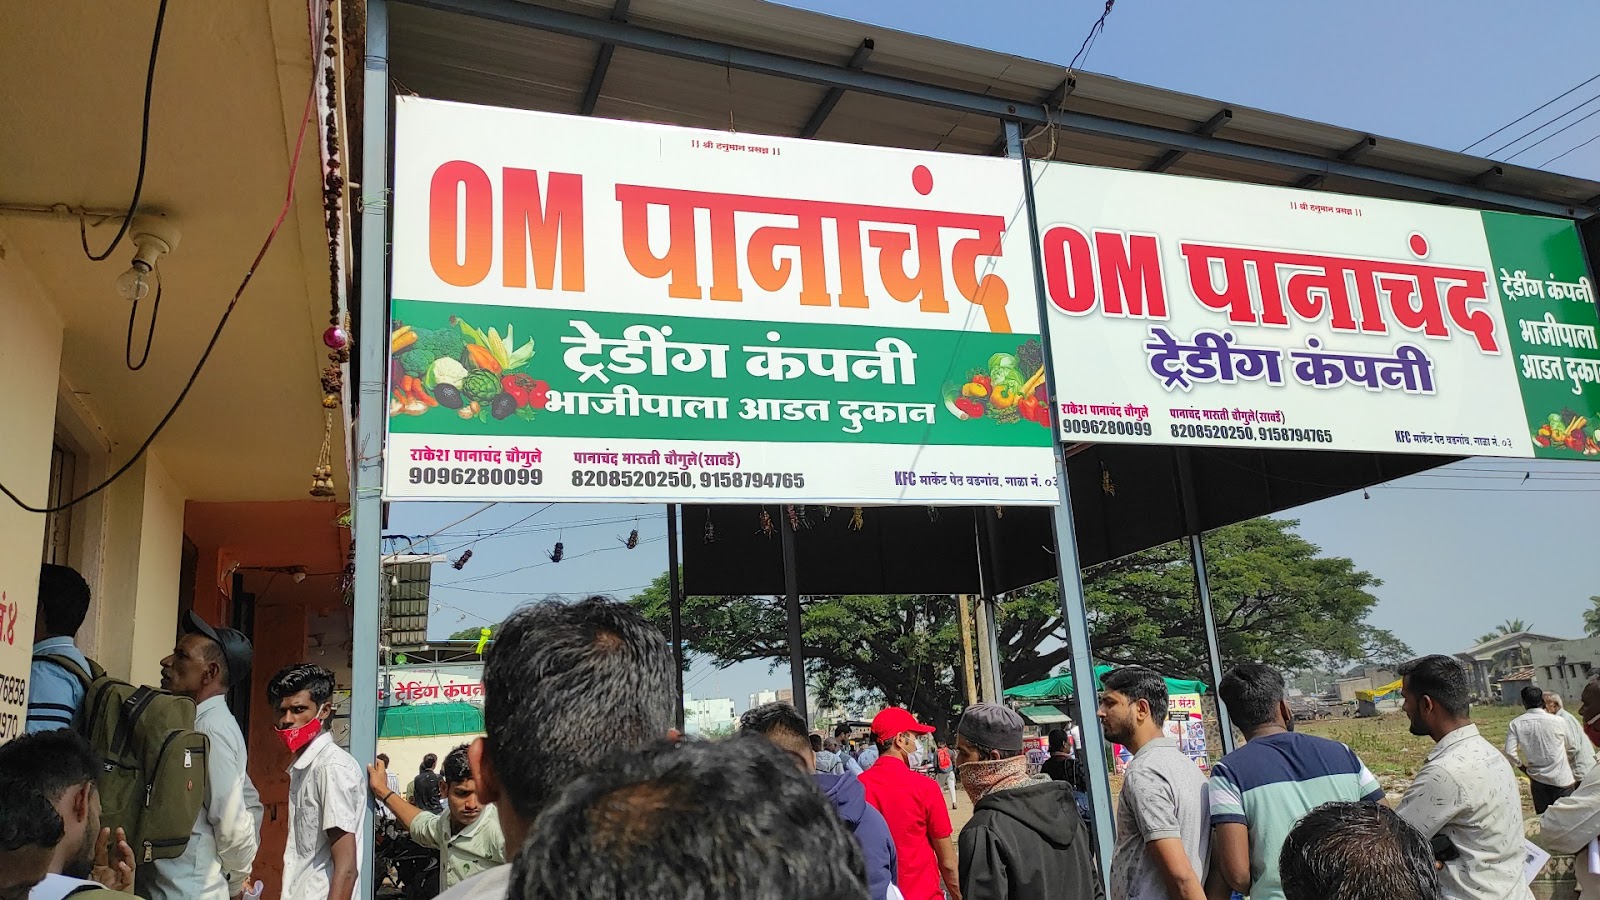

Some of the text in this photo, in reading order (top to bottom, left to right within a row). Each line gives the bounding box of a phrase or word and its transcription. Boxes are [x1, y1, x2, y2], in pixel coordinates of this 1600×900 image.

[716, 143, 745, 152] हनुमान
[747, 146, 769, 154] प्रसन्न
[429, 159, 1013, 333] OM पानाचंद
[1043, 226, 1499, 353] OM पानाचंद
[1500, 268, 1595, 304] ट्रेडींग कंपनी
[1519, 312, 1599, 350] भाजीपाला
[560, 319, 918, 385] ट्रेडींग कंपनी
[1146, 328, 1434, 392] ट्रेडींग कंपनी
[1520, 354, 1600, 396] आडत दुका
[545, 384, 937, 434] भाजीपाला आडत दुकान
[1061, 402, 1149, 422] राकेश पानाचंद चौगुले
[1169, 405, 1201, 422] पानाचंद
[1063, 419, 1152, 437] 9096280099
[1395, 430, 1411, 443] KFC
[410, 445, 542, 468] राकेश पानाचंद चौगुले
[573, 448, 618, 467] पानाचंद
[409, 467, 543, 485] 9096280099
[894, 471, 916, 486] KFC
[919, 471, 947, 486] मार्केट
[950, 472, 964, 486] पेठ
[1005, 475, 1028, 487] गाळा
